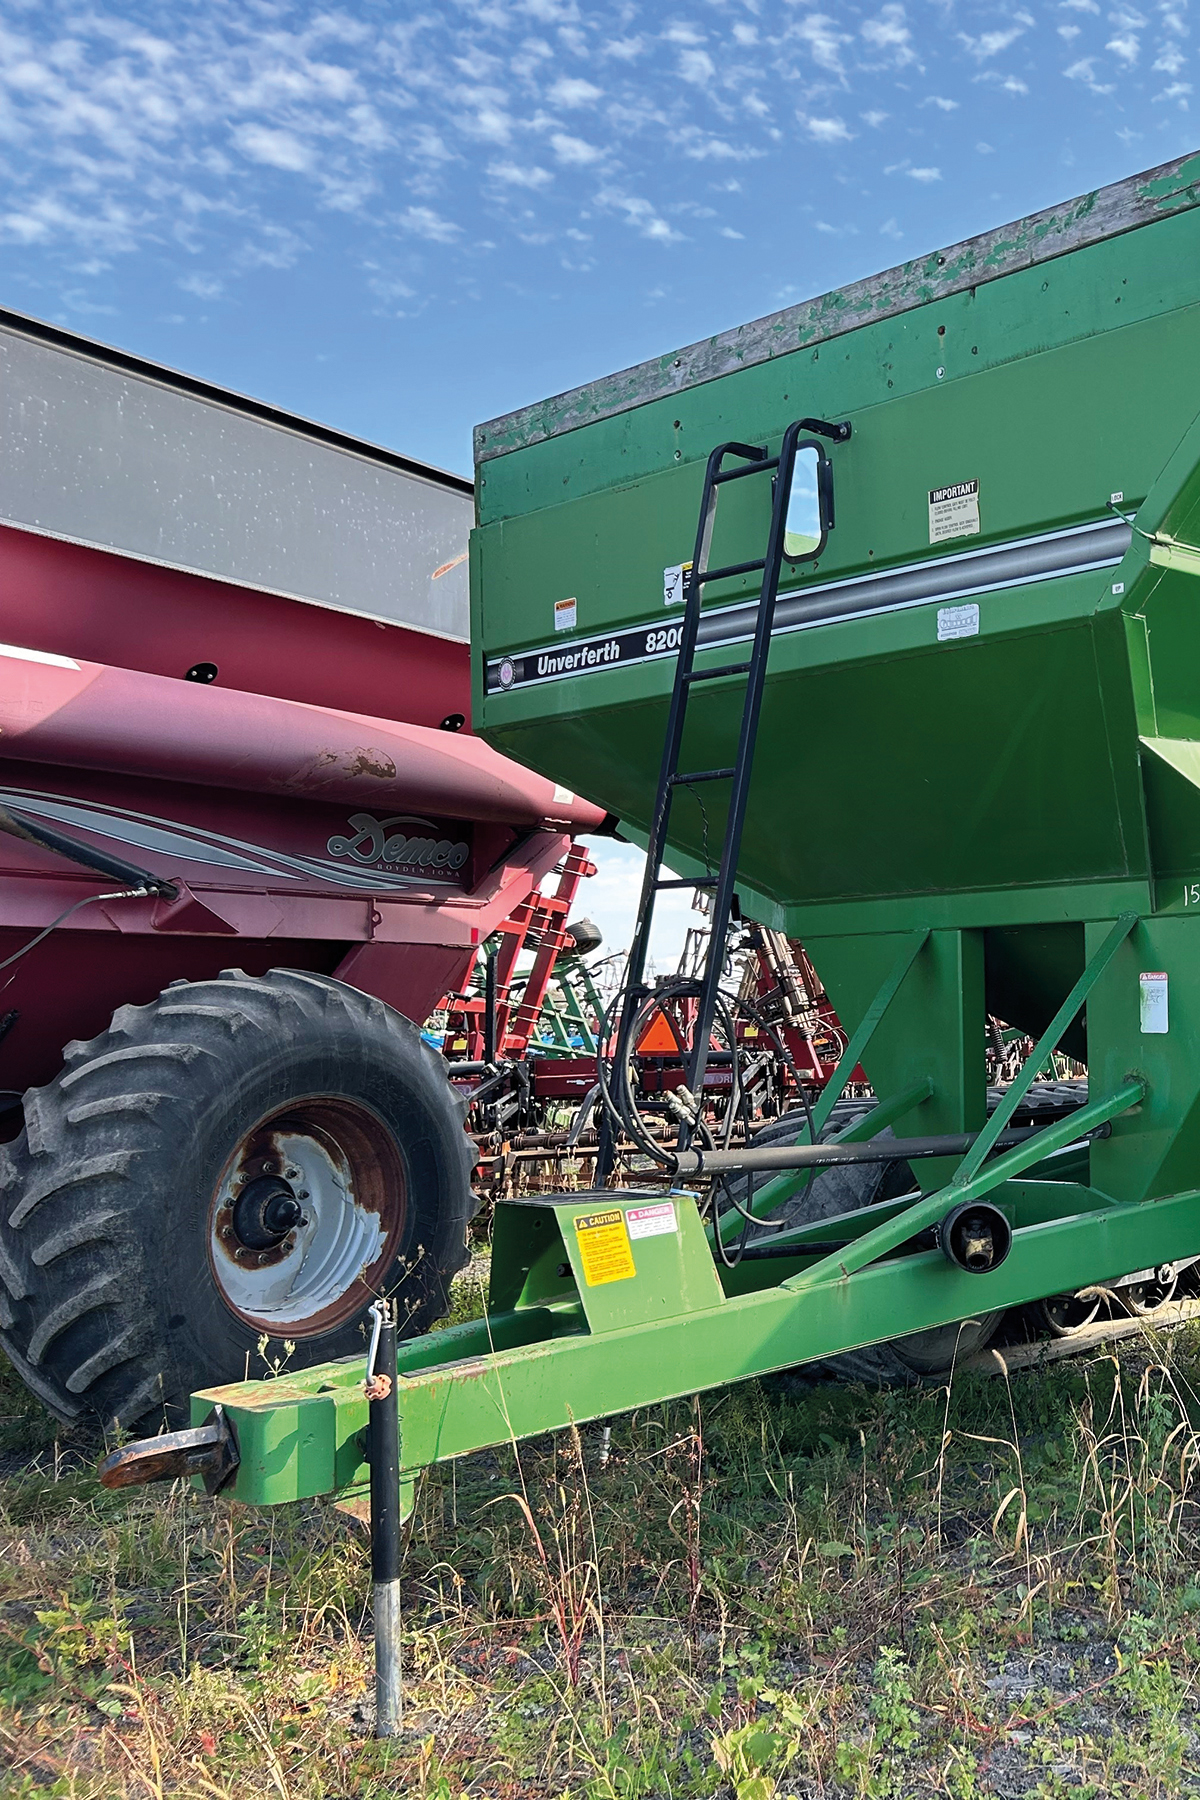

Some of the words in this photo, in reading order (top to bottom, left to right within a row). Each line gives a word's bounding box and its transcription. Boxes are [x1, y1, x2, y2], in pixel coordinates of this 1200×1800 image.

[933, 481, 976, 502] IMPORTANT
[1112, 493, 1122, 501] LOCK
[537, 640, 620, 676] Unverferth
[326, 812, 470, 870] Demco
[432, 869, 460, 878] IOWA
[589, 1212, 621, 1226] CAUTION
[638, 1206, 670, 1219] DANGER
